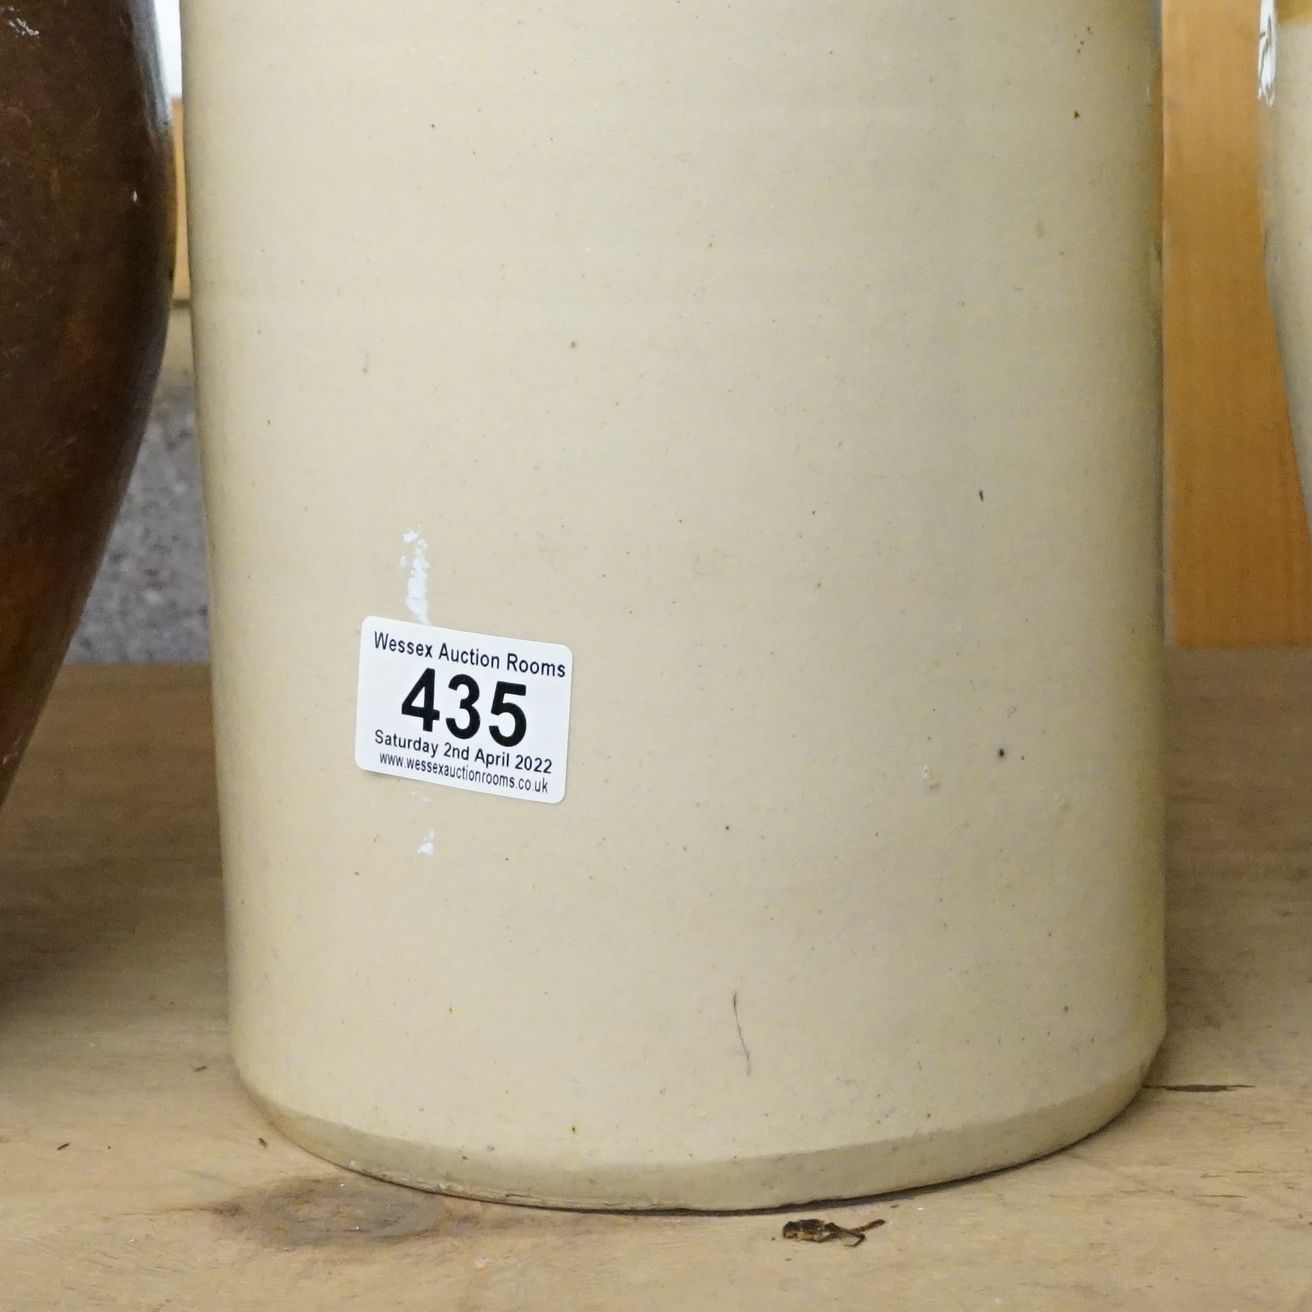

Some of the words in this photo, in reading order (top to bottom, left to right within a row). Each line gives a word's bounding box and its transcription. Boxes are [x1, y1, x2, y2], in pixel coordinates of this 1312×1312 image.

[374, 630, 434, 658] Wessex
[438, 642, 500, 670] Auction
[507, 653, 566, 678] Rooms
[401, 667, 527, 748] 435
[374, 729, 439, 758] Saturday
[444, 742, 470, 761] 2nd
[474, 748, 510, 769] April
[515, 754, 552, 774] 2022
[379, 752, 549, 794] www.wessexauctionrooms.co.uk
